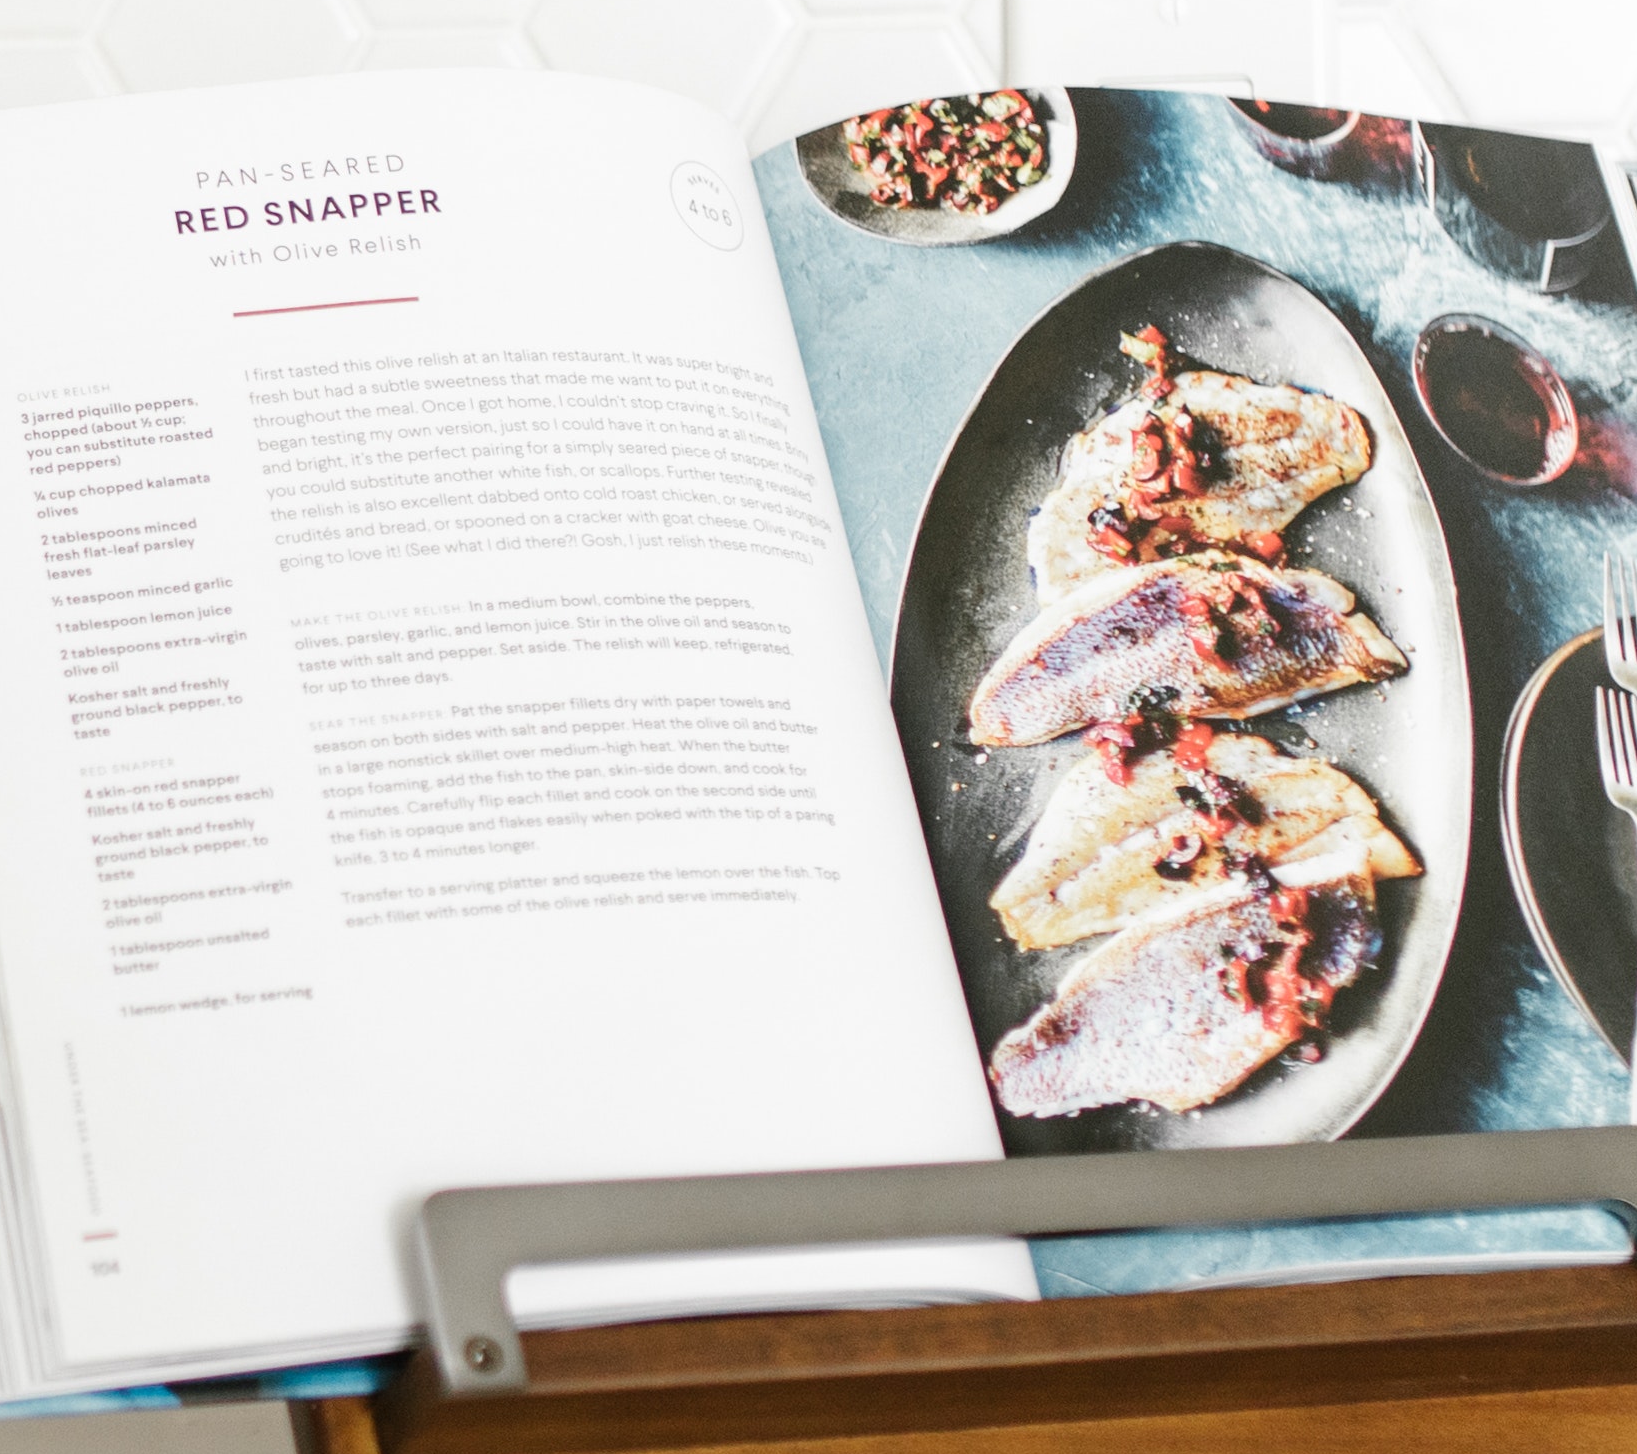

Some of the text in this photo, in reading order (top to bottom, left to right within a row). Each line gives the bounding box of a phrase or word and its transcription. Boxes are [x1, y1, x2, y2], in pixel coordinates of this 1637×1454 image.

[196, 155, 404, 190] PAN-SEARED
[174, 189, 441, 236] RED SNAPPER
[689, 199, 732, 226] 4 to 6
[210, 234, 421, 268] with Olive Relish
[253, 368, 285, 381] first
[288, 361, 340, 378] tasted
[343, 359, 373, 373] this
[375, 356, 414, 371] olive
[418, 352, 459, 367] relish
[463, 353, 478, 365] at
[482, 353, 500, 364] an
[503, 349, 549, 363] Italian
[552, 351, 629, 364] restaurant.
[632, 351, 642, 365] It
[646, 355, 674, 367] was
[676, 357, 713, 372] super
[716, 361, 752, 380] bright
[753, 372, 775, 388] and
[17, 383, 111, 404] OLIVE RELISH
[249, 389, 290, 405] fresh
[293, 388, 320, 402] but
[324, 383, 355, 398] had
[359, 385, 368, 396] a
[371, 378, 421, 395] subtle
[424, 375, 507, 391] sweetness
[511, 372, 541, 386] that
[545, 372, 588, 385] made
[591, 375, 615, 386] me
[618, 376, 653, 387] want
[656, 377, 672, 389] to
[675, 379, 698, 392] put
[701, 381, 710, 393] it
[713, 384, 730, 396] on
[21, 398, 199, 427] 3 jarred piquillo peppers,
[253, 409, 342, 429] throughout
[345, 406, 372, 420] the
[376, 401, 418, 417] meal.
[421, 399, 467, 414] Once
[478, 398, 504, 412] got
[507, 395, 555, 409] home,
[567, 394, 627, 409] couldn't
[631, 398, 664, 412] stop
[666, 401, 716, 419] craving
[717, 404, 730, 418] it.
[731, 406, 749, 422] So
[24, 423, 89, 442] chopped
[91, 420, 138, 435] (about
[27, 427, 214, 462] you can substitute roasted
[29, 455, 122, 476] red peppers)
[49, 489, 77, 502] cup
[79, 479, 144, 497] chopped
[146, 474, 211, 490] kalamata
[266, 463, 813, 503] you could substitute another white fish, or scallops. Further testing revealed
[37, 506, 79, 520] olives
[41, 517, 198, 546] 2 tablespoons minced
[44, 537, 195, 563] fresh flat-leaf parsley
[279, 553, 325, 571] going
[326, 552, 345, 565] to
[347, 548, 383, 562] love
[386, 545, 402, 559] it!
[405, 542, 441, 558] (See
[444, 539, 484, 554] what
[496, 536, 522, 551] did
[525, 534, 578, 550] there?!
[581, 533, 626, 548] Gosh,
[637, 534, 664, 549] just
[667, 534, 706, 549] relish
[708, 536, 748, 553] these
[47, 567, 93, 581] leaves
[65, 590, 135, 606] teaspoon
[137, 581, 191, 598] minced
[194, 577, 233, 595] garlic
[65, 616, 148, 633] tablespoon
[150, 611, 195, 623] lemon
[197, 605, 233, 622] juice
[60, 630, 248, 661] 2 tablespoons extra-virgin
[63, 661, 120, 678] olive oil
[68, 677, 230, 705] Kosher salt and freshly
[302, 682, 324, 695] for
[327, 681, 349, 694] up
[350, 679, 368, 690] to
[370, 675, 411, 689] three
[71, 695, 244, 725] ground black pepper, to
[73, 727, 111, 740] taste
[79, 757, 176, 778] RED SNAPPER
[84, 775, 240, 800] 4 skin-on red snapper
[87, 787, 274, 818] fillets (4 to 6 ounces each)
